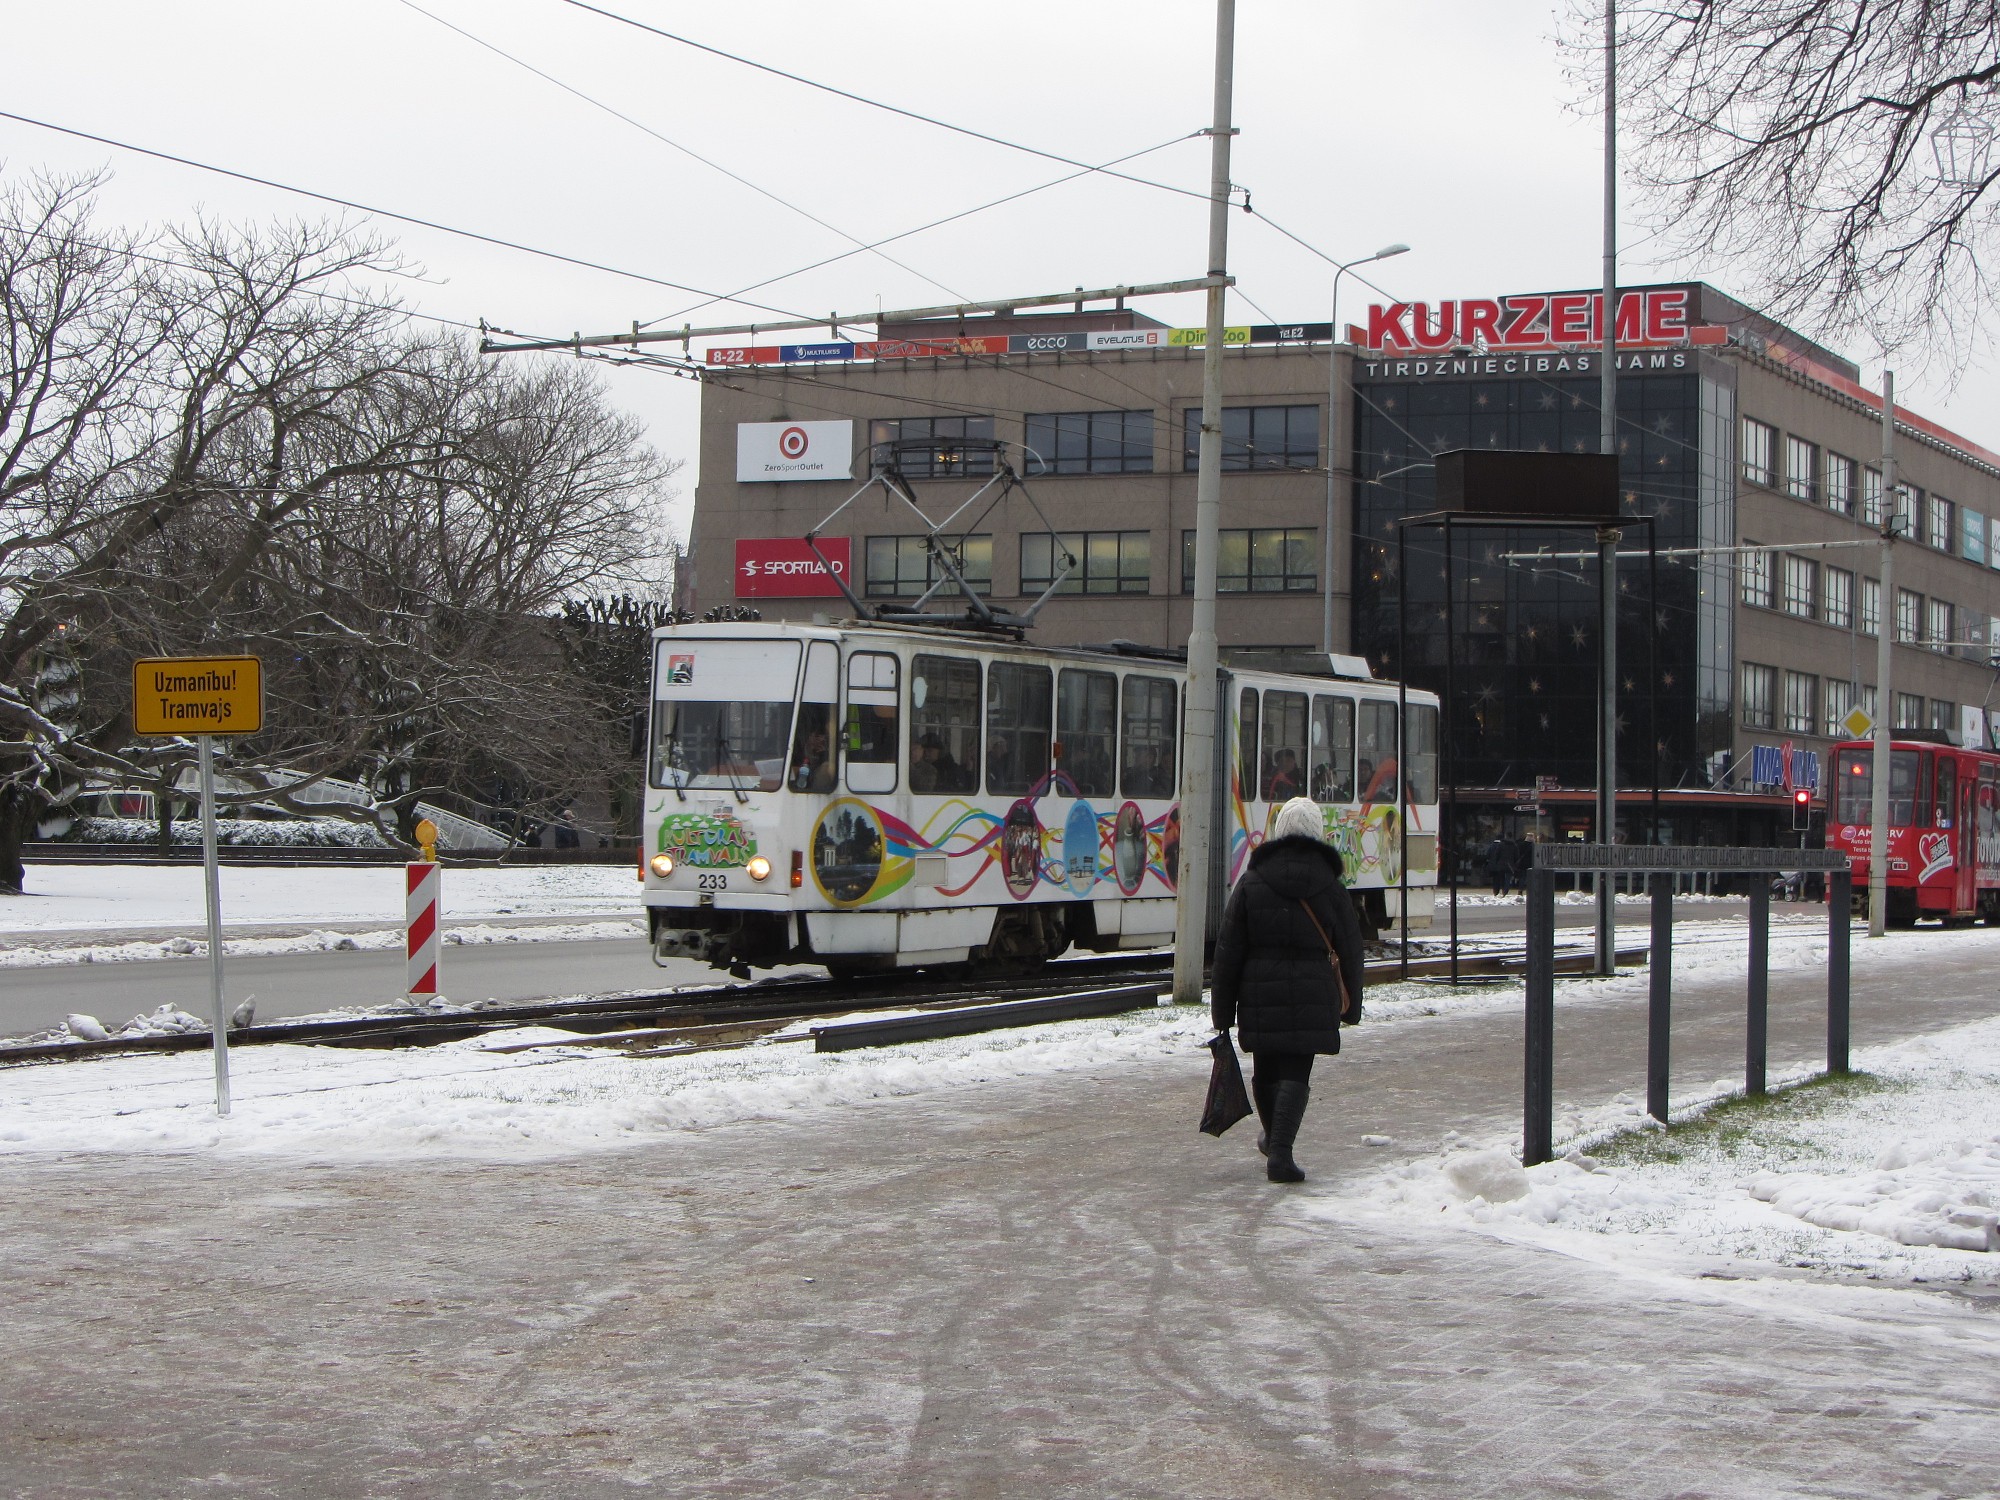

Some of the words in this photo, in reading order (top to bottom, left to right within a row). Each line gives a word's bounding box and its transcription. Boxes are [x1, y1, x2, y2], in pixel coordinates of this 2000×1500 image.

[1368, 290, 1688, 351] KURZEME
[1097, 335, 1144, 345] EVELATUS
[1186, 329, 1246, 344] DinZoo
[1279, 327, 1304, 339] TELE2
[1027, 335, 1067, 349] ecco
[713, 350, 744, 363] 8-22
[1366, 355, 1590, 377] TIRDZNIECĪBAS
[764, 463, 824, 472] ZeroSportOutlet
[154, 670, 237, 693] Uzmanību!
[160, 697, 232, 723] Tramvajs
[1858, 828, 1904, 838] AMRV
[698, 873, 727, 890] 233
